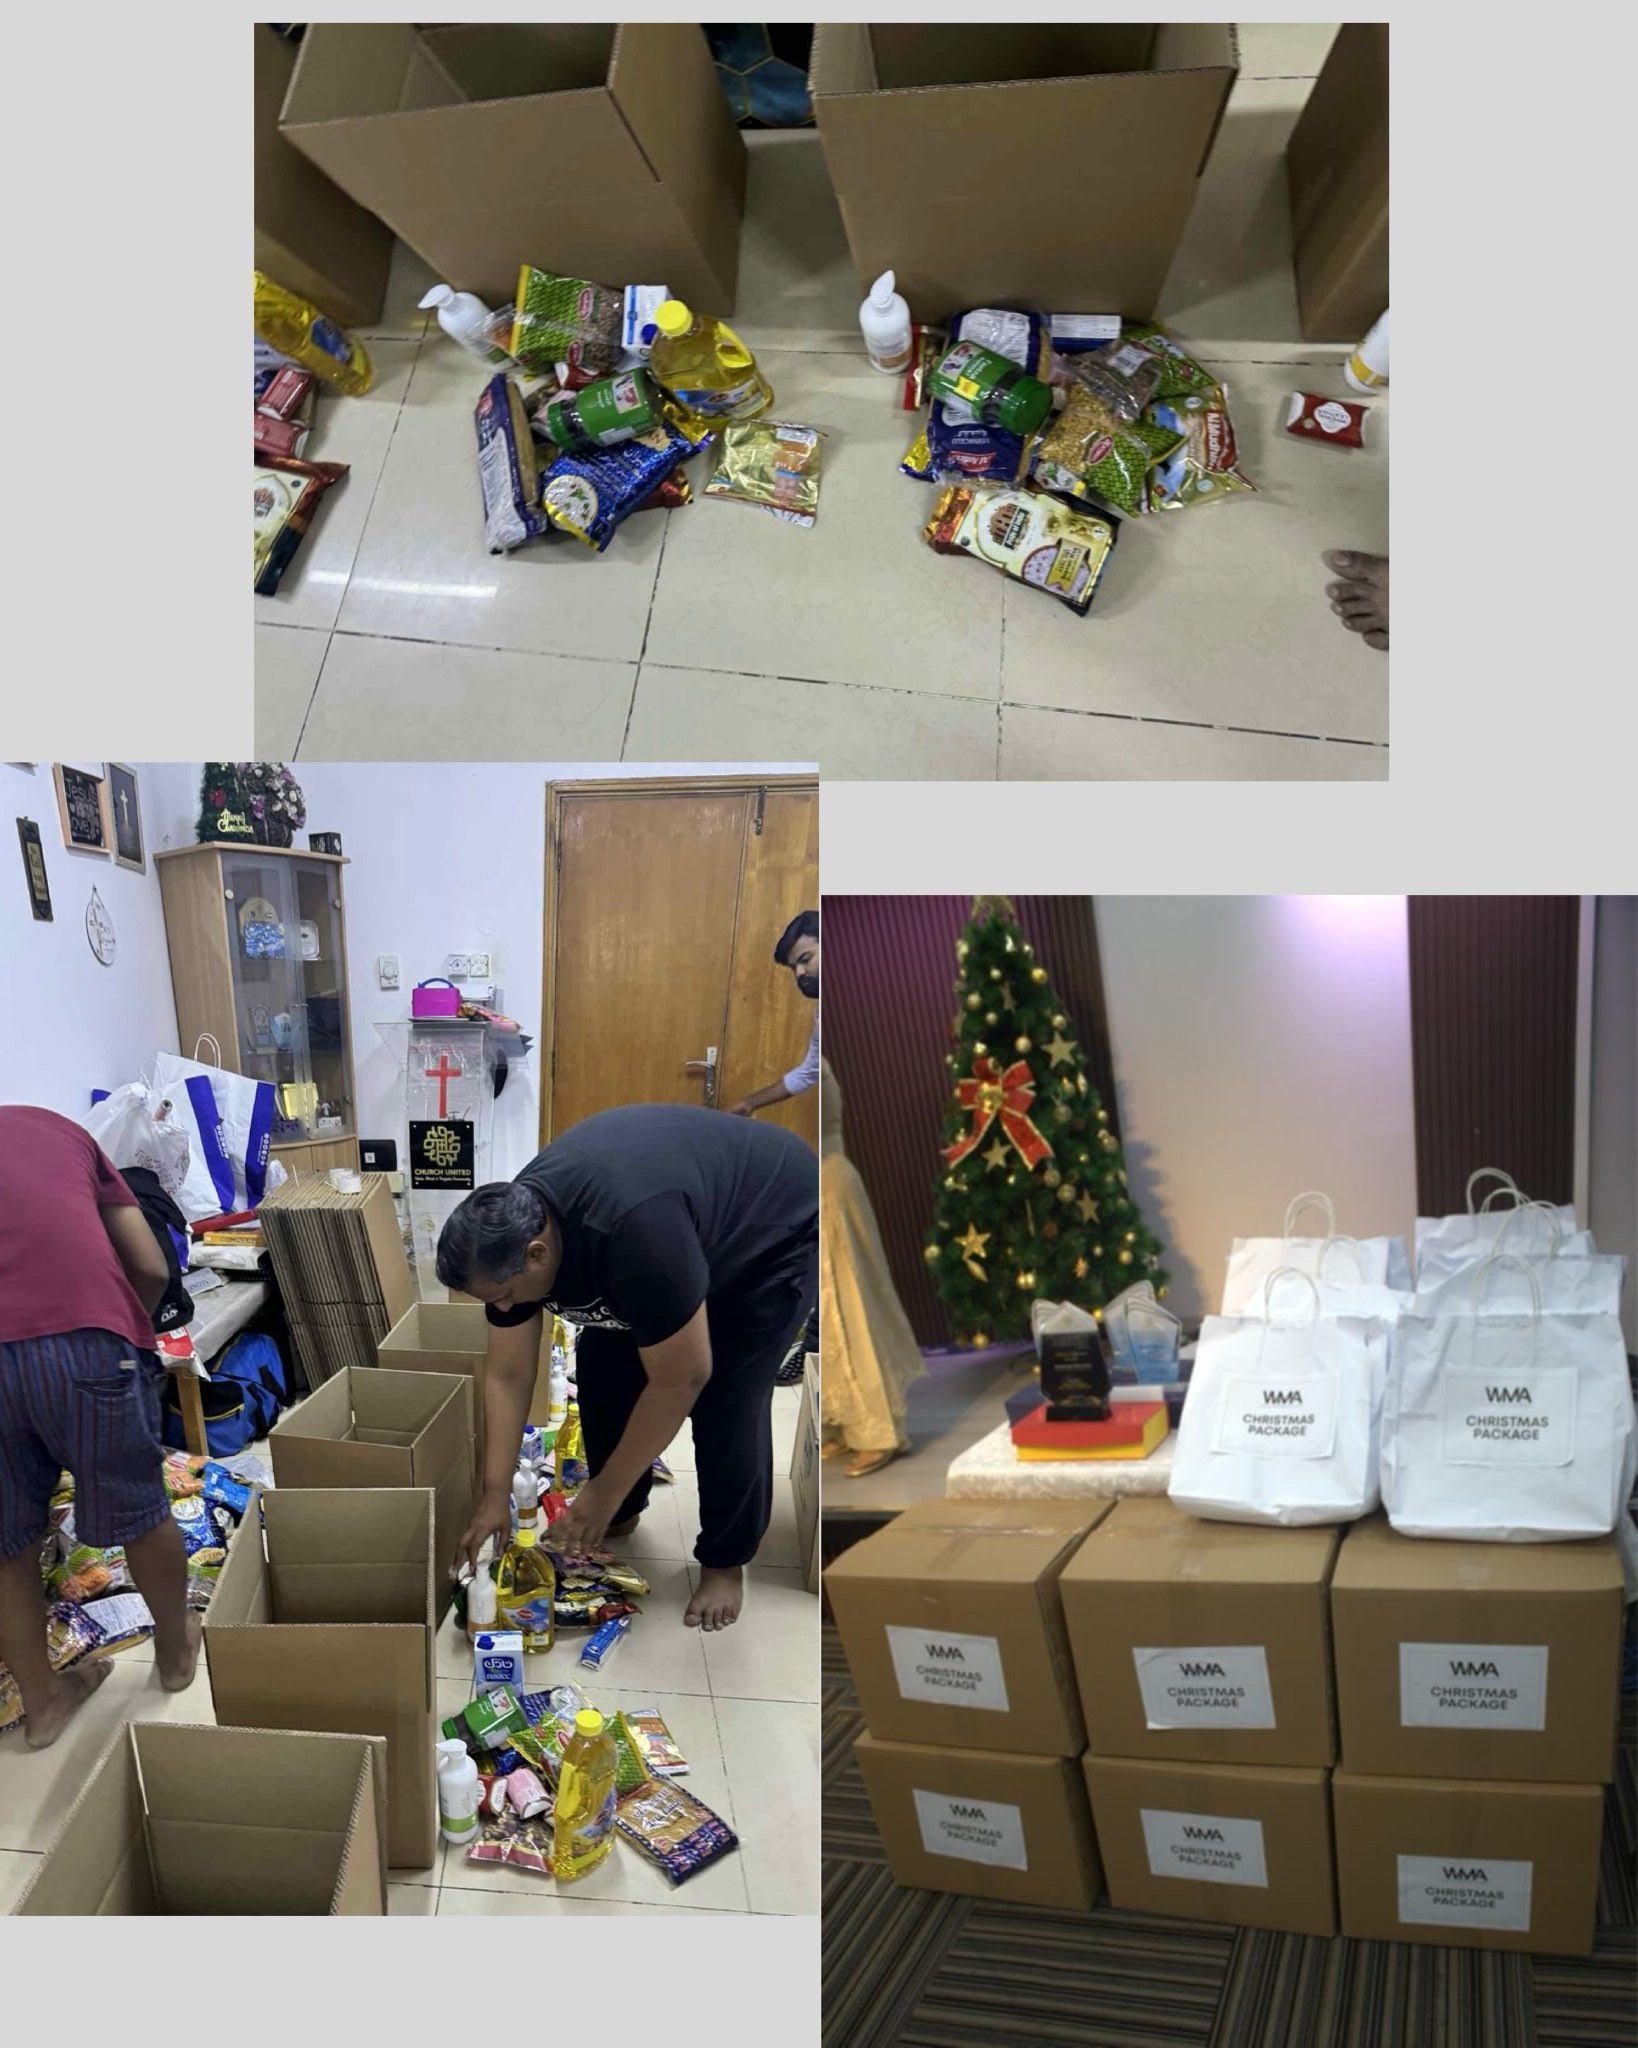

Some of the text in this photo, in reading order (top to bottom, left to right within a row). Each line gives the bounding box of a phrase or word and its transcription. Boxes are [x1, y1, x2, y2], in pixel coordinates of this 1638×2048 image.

[414, 1168, 472, 1176] CHURCH UNITED
[1263, 1389, 1304, 1406] WMA
[1485, 1387, 1532, 1404] WMA
[1242, 1413, 1315, 1426] CHRISTMAS
[1465, 1414, 1549, 1428] CHRISTMAS
[1247, 1424, 1307, 1437] PACKAGE
[1473, 1427, 1539, 1441] PACKAGE
[925, 1644, 965, 1661] WMA
[916, 1665, 983, 1683] CHRISTMAS
[1179, 1662, 1226, 1677] WMA
[1449, 1660, 1500, 1679] WMA
[924, 1676, 978, 1692] PACKAGE
[1167, 1687, 1245, 1697] CHRISTMAS
[1430, 1686, 1518, 1700] CHRISTMAS
[1176, 1697, 1238, 1709] PACKAGE
[1439, 1697, 1508, 1711] PACKAGE
[950, 1803, 986, 1820] WMA
[940, 1821, 1003, 1839] CHRISTMAS
[1182, 1826, 1225, 1842] WMA
[948, 1831, 998, 1848] PACKAGE
[1170, 1844, 1242, 1861] CHRISTMAS
[1179, 1855, 1235, 1870] PACKAGE
[1442, 1866, 1489, 1882] WMA
[1425, 1886, 1506, 1900] CHRISTMAS
[1433, 1897, 1495, 1909] PACKAGE
